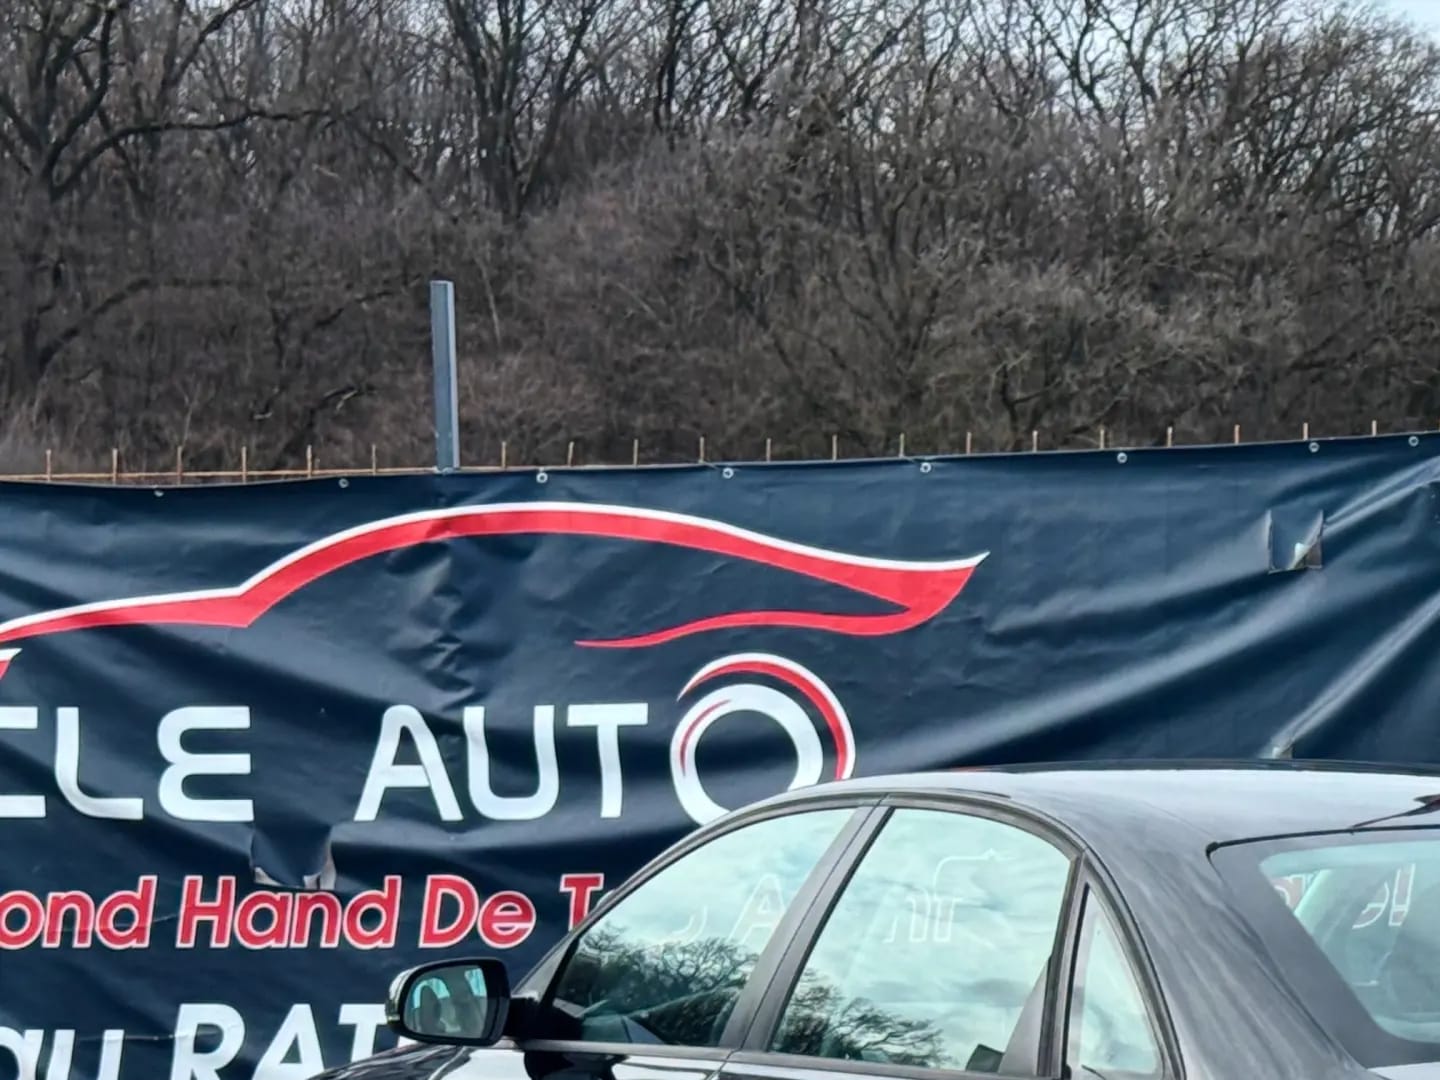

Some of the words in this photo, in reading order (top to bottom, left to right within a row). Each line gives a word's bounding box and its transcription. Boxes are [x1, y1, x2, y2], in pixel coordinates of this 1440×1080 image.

[354, 684, 824, 827] AUTO
[175, 875, 402, 949] Hand
[419, 876, 536, 949] De
